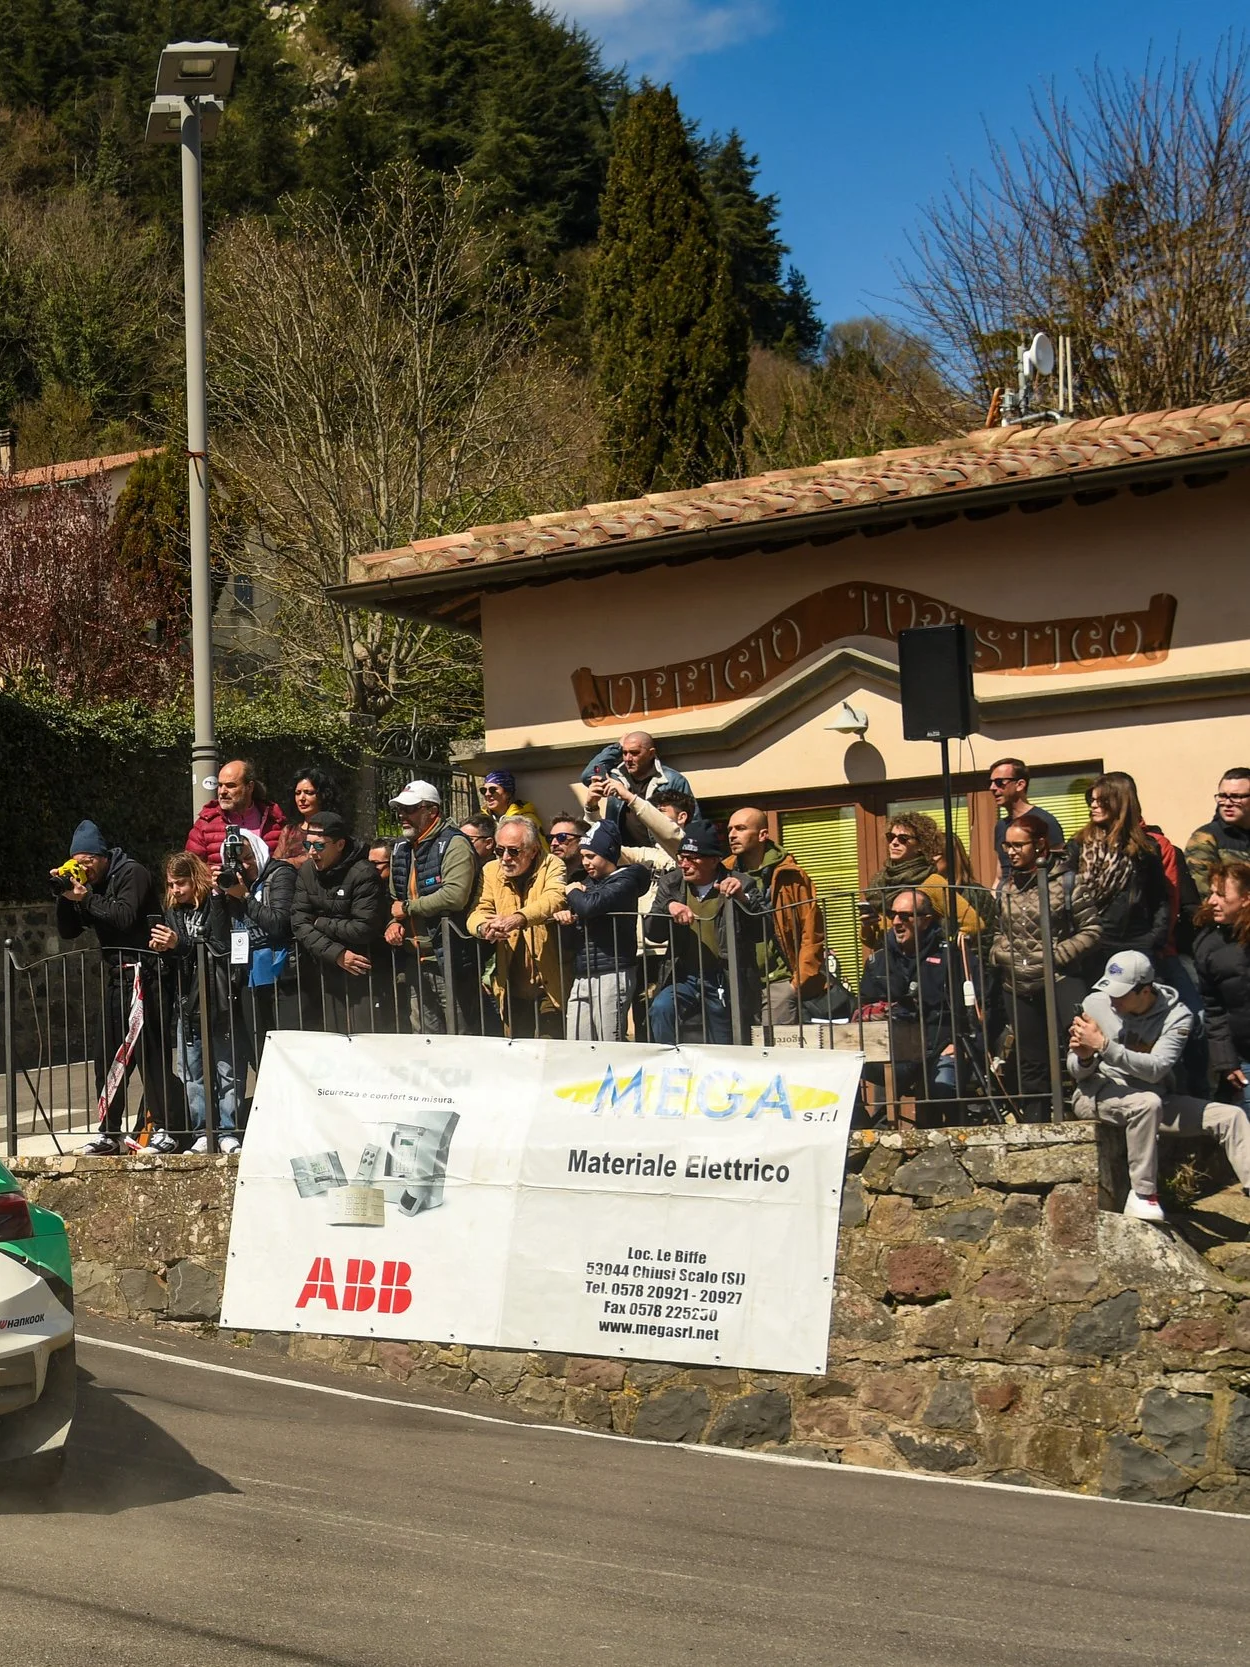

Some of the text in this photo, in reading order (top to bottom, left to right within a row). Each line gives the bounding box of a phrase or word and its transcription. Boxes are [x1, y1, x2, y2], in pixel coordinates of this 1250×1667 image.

[317, 1088, 359, 1098] Sicurezza
[370, 1092, 406, 1101] comfort
[421, 1096, 455, 1104] misura.
[590, 1063, 793, 1121] MEGA
[567, 1149, 790, 1183] Materiale Elettrico
[627, 1247, 707, 1264] Loc. Le Biffe
[295, 1257, 412, 1314] ABB
[586, 1262, 746, 1286] 53044 Chiusi Scalo (SI)
[585, 1280, 608, 1295] Tel.
[611, 1282, 644, 1297] 0578
[646, 1285, 689, 1301] 20921
[699, 1289, 742, 1305] 20927
[604, 1300, 626, 1315] Fax
[629, 1302, 662, 1317] 0578
[598, 1320, 720, 1341] www.megasrl.net
